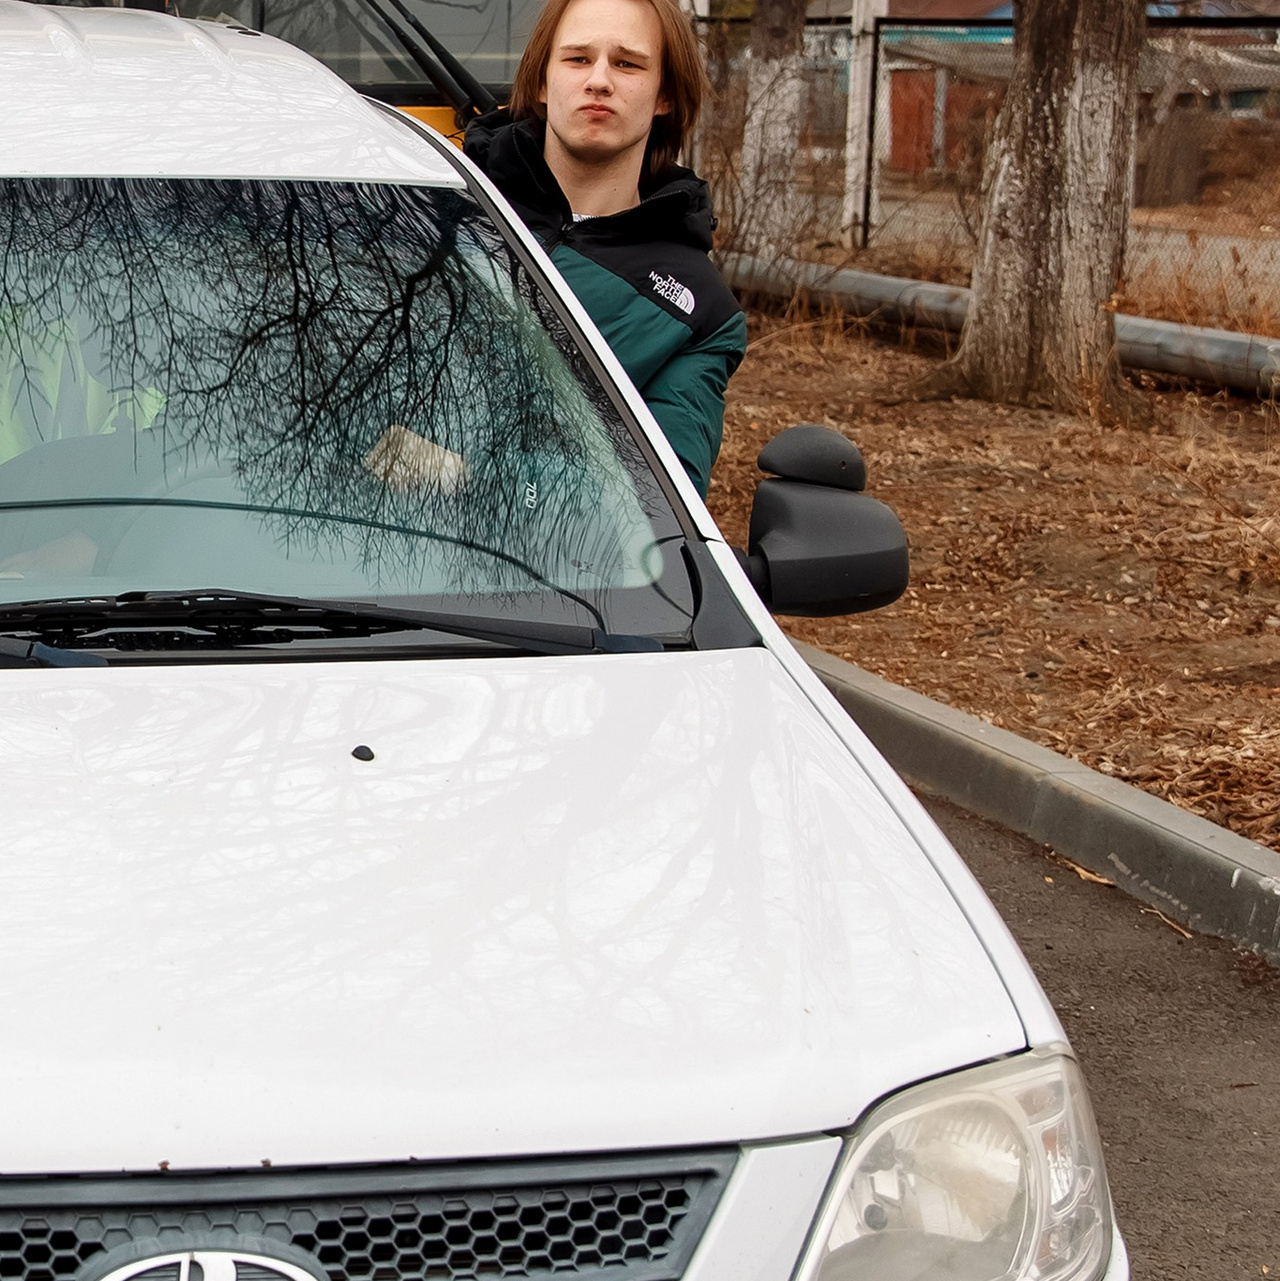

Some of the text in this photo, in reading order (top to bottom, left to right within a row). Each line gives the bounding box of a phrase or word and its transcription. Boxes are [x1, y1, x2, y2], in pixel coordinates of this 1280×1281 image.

[648, 270, 683, 298] NORTH
[652, 283, 679, 304] FACE
[667, 274, 685, 292] THE
[525, 480, 537, 509] 700
